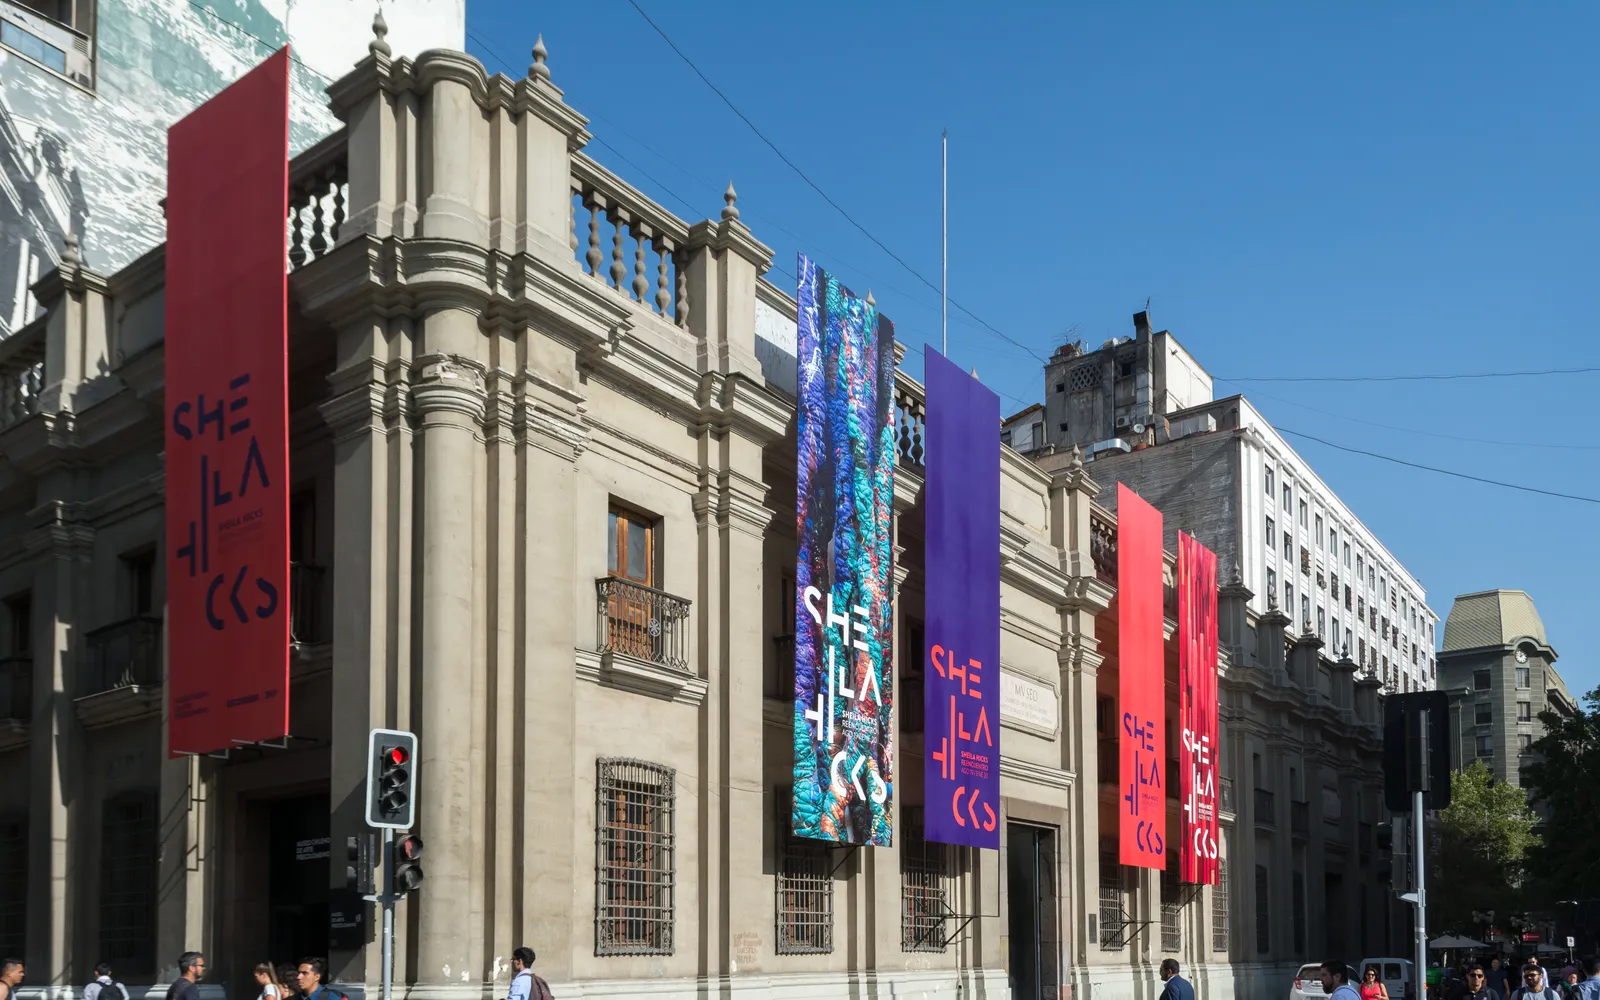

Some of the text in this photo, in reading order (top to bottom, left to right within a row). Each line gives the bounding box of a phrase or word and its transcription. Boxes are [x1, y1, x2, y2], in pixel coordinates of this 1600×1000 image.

[173, 373, 250, 441] SHE
[206, 566, 278, 630] CKS
[804, 585, 869, 652] SHE
[931, 644, 982, 699] SHE
[1123, 712, 1154, 751] SHE
[1183, 728, 1209, 764] SHE
[831, 751, 887, 804] CKS
[961, 750, 988, 764] SHEILA HICKS
[961, 759, 988, 771] REENCUENTRO
[952, 786, 997, 832] CKS
[1137, 821, 1163, 855] CKS
[1194, 828, 1217, 859] CKS
